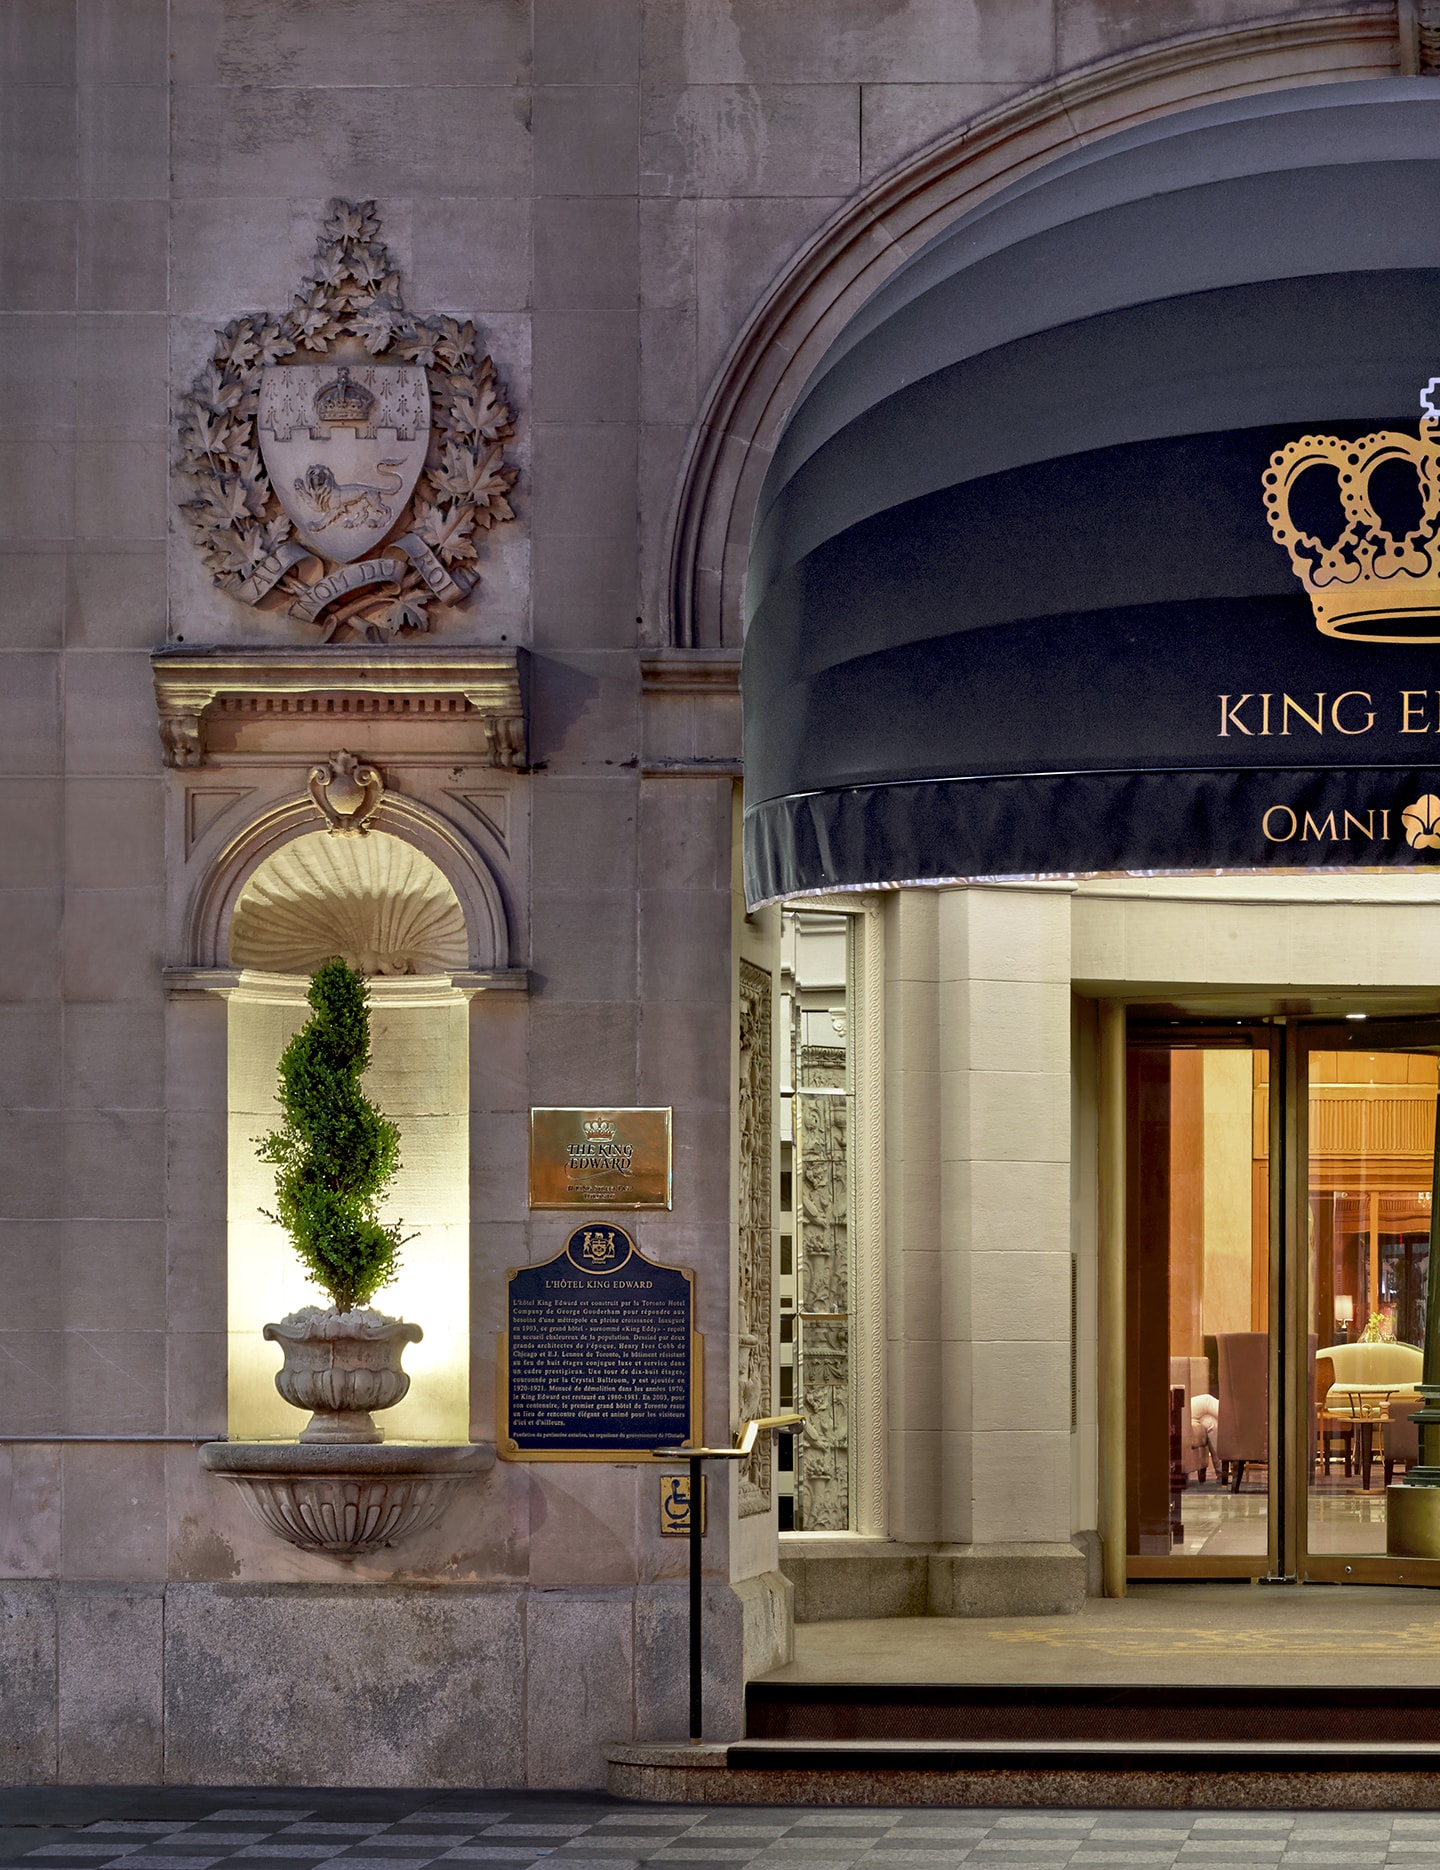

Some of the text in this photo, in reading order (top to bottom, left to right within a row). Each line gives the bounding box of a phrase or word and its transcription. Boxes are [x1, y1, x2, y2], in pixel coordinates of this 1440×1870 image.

[252, 554, 284, 596] AU
[297, 573, 349, 616] NOM
[359, 559, 398, 581] DU
[1217, 690, 1375, 737] KING
[1262, 804, 1390, 842] OMNI
[567, 1144, 633, 1158] THE KING
[568, 1157, 632, 1172] EDWARD
[545, 1278, 653, 1288] L'HÔTEL KING EDWARD
